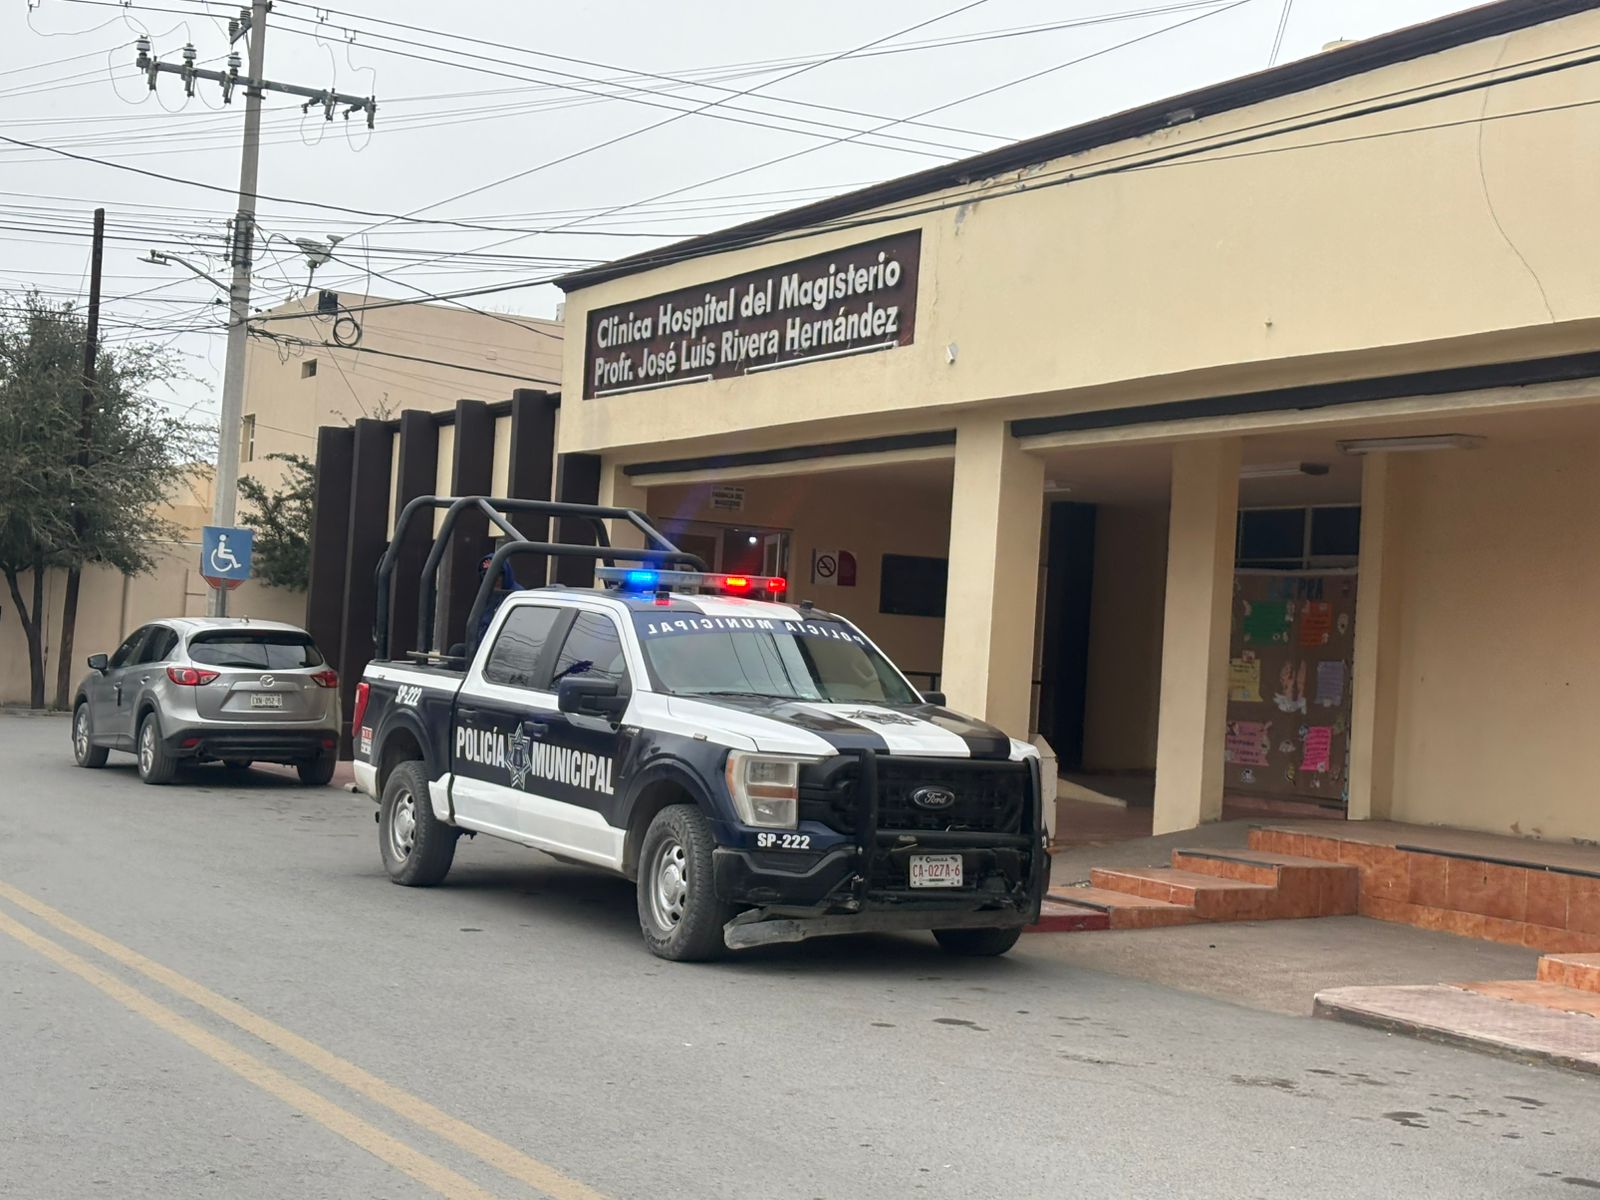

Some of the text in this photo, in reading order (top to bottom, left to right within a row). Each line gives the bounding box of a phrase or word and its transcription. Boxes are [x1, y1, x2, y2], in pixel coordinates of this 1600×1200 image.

[658, 288, 734, 339] Hospital
[740, 279, 772, 317] del
[778, 251, 900, 311] Magisterio
[638, 342, 676, 378] José
[681, 339, 716, 370] Luis
[721, 325, 779, 362] Rivera
[785, 302, 898, 351] Hernández
[456, 726, 506, 769] POLICÍA
[532, 741, 615, 795] MUNICIPAL
[924, 792, 947, 804] Ford
[757, 833, 811, 850] SP-222
[912, 864, 960, 878] CA-027A-6
